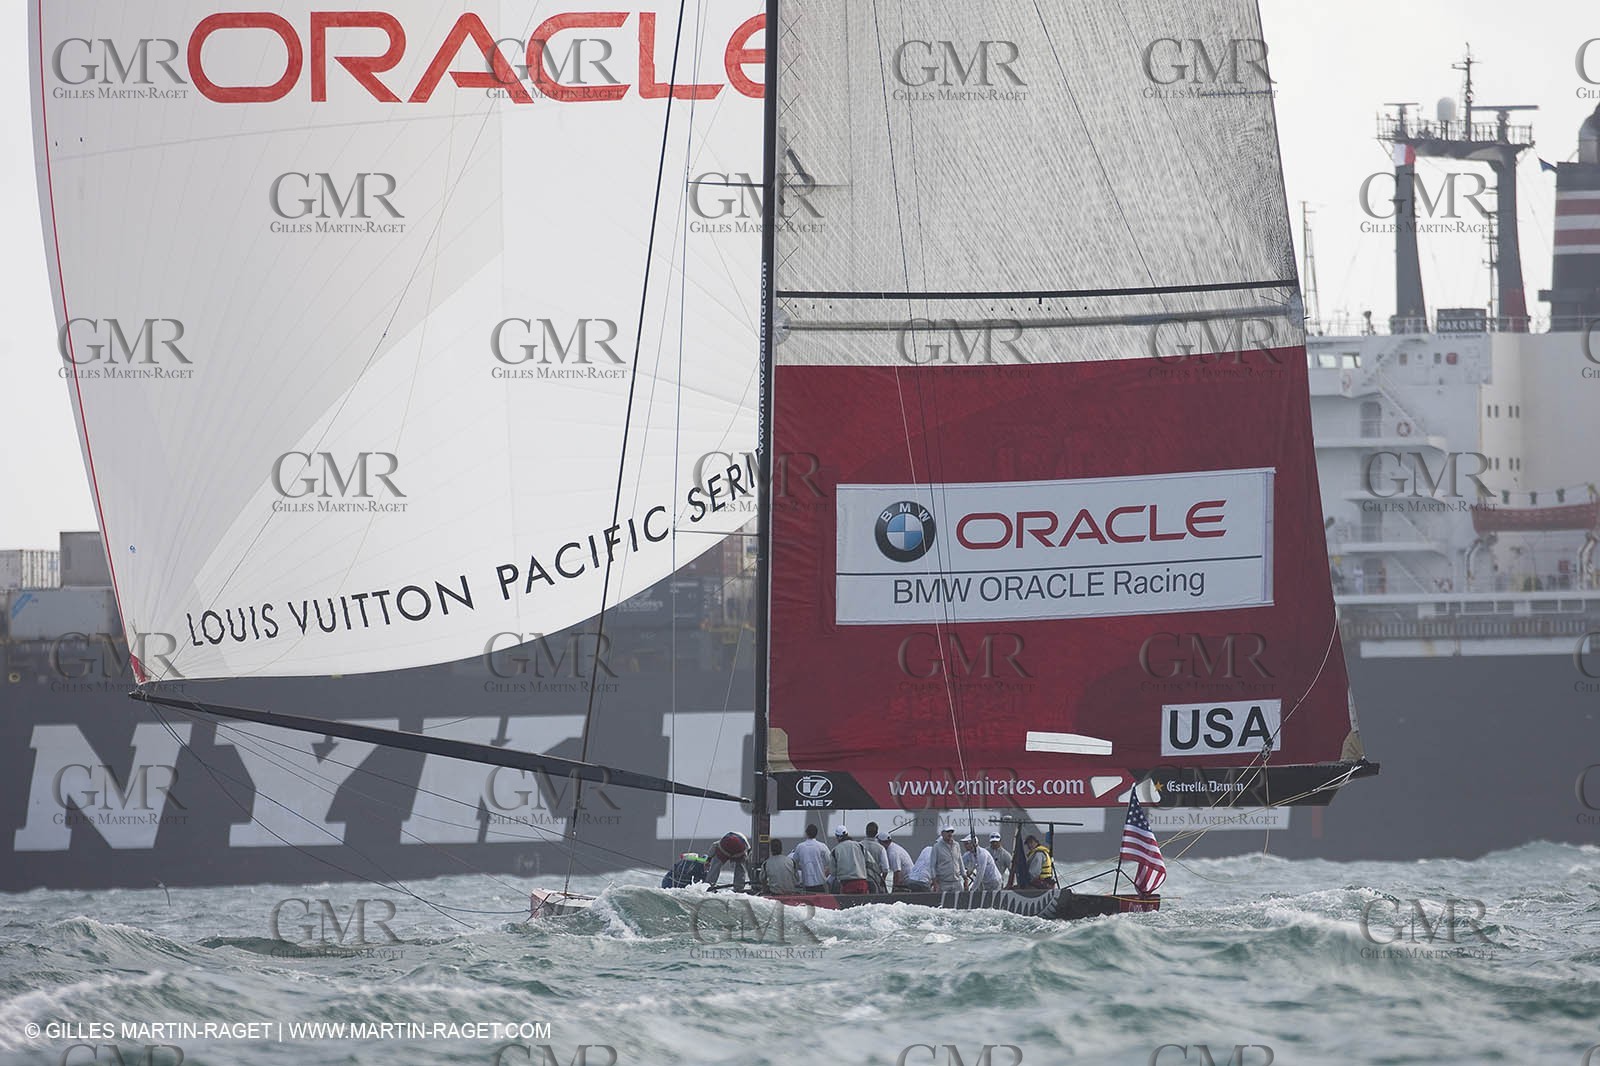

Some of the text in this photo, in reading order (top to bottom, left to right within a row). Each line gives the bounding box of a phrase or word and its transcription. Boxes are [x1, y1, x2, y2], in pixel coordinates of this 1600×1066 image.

[880, 503, 931, 522] BMW
[956, 499, 1228, 551] ORACLE
[187, 603, 279, 646] LOUIS
[288, 574, 474, 635] VUITTON
[495, 505, 669, 601] PACIFIC
[893, 567, 1206, 604] BMW ORACLE Racing
[1168, 705, 1274, 751] USA
[14, 716, 587, 851] NYK
[888, 776, 1085, 796] www.emirates.com
